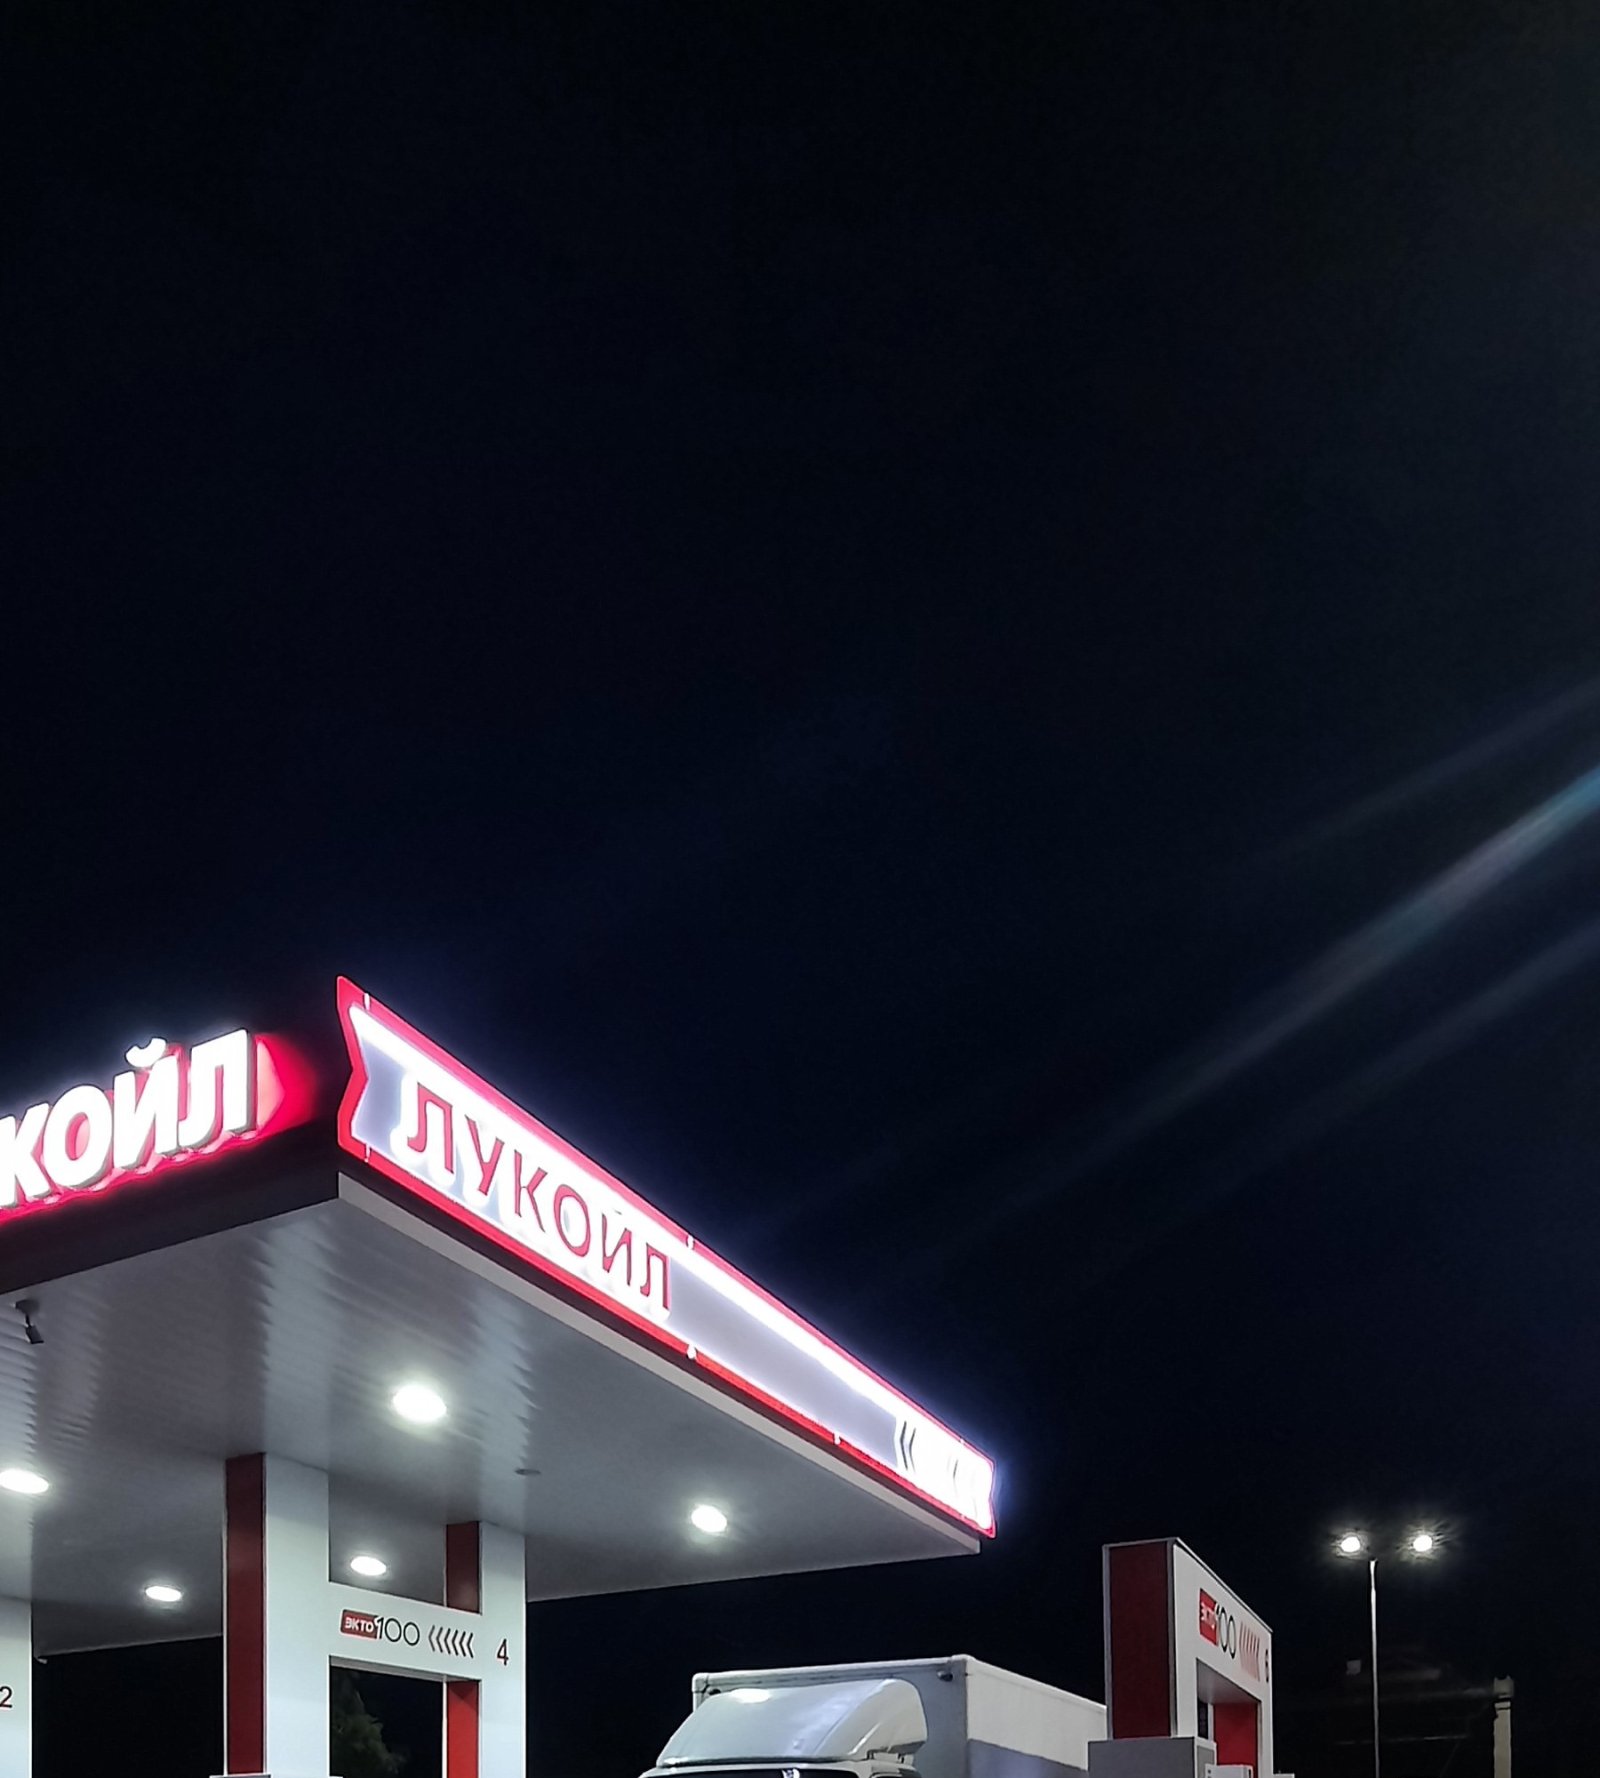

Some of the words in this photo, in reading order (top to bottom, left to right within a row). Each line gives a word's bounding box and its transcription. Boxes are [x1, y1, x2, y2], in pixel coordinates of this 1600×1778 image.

[344, 1616, 374, 1634] ЭКТО
[376, 1616, 420, 1647] 100
[496, 1638, 509, 1667] 4
[0, 1685, 13, 1709] 2
